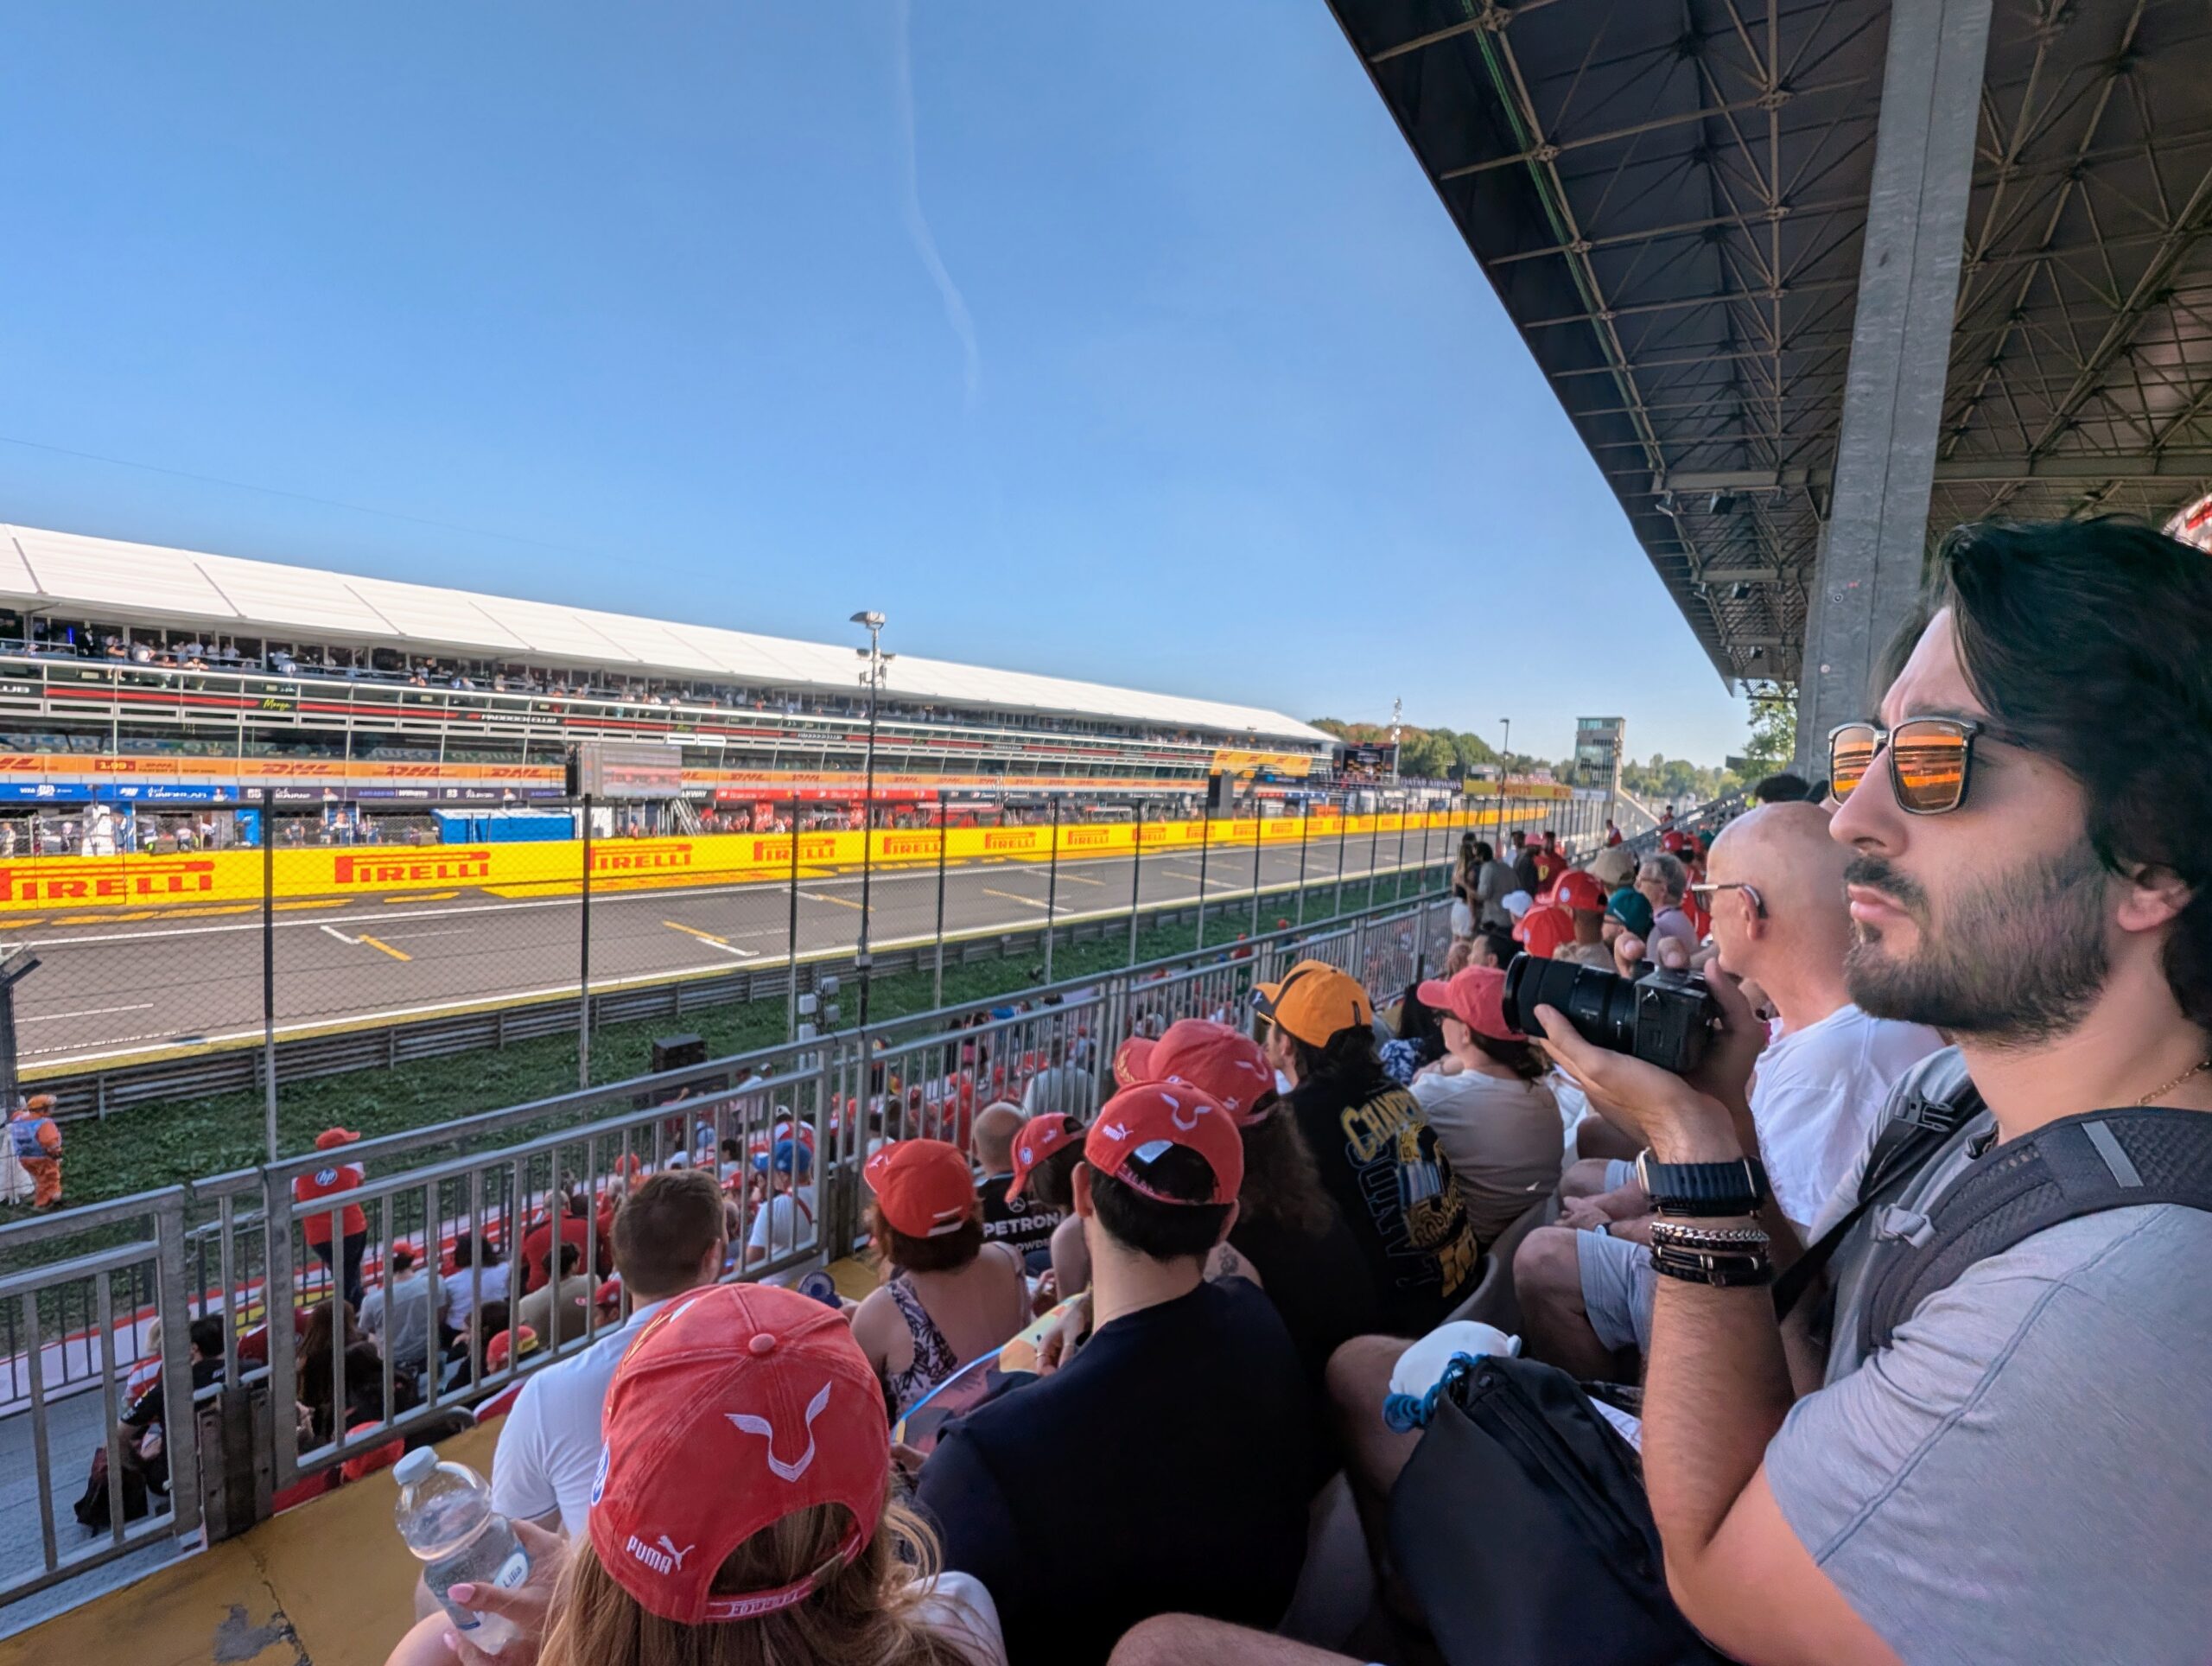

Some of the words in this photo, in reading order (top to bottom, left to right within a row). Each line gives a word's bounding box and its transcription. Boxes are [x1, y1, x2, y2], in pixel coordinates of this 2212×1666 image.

[261, 763, 333, 775] DHL
[385, 766, 442, 777] DHL
[491, 767, 543, 778] DHL
[884, 836, 945, 855] PIRELL
[985, 831, 1036, 849] PIRELLI
[1068, 829, 1109, 845] PIRELLI
[589, 843, 692, 871] PIRELLI
[753, 838, 836, 862] PIRELLI
[334, 851, 491, 883] PIRELLI
[0, 862, 215, 900] PIRELLI
[626, 1535, 673, 1575] PUMA
[503, 1566, 523, 1588] Lilia
